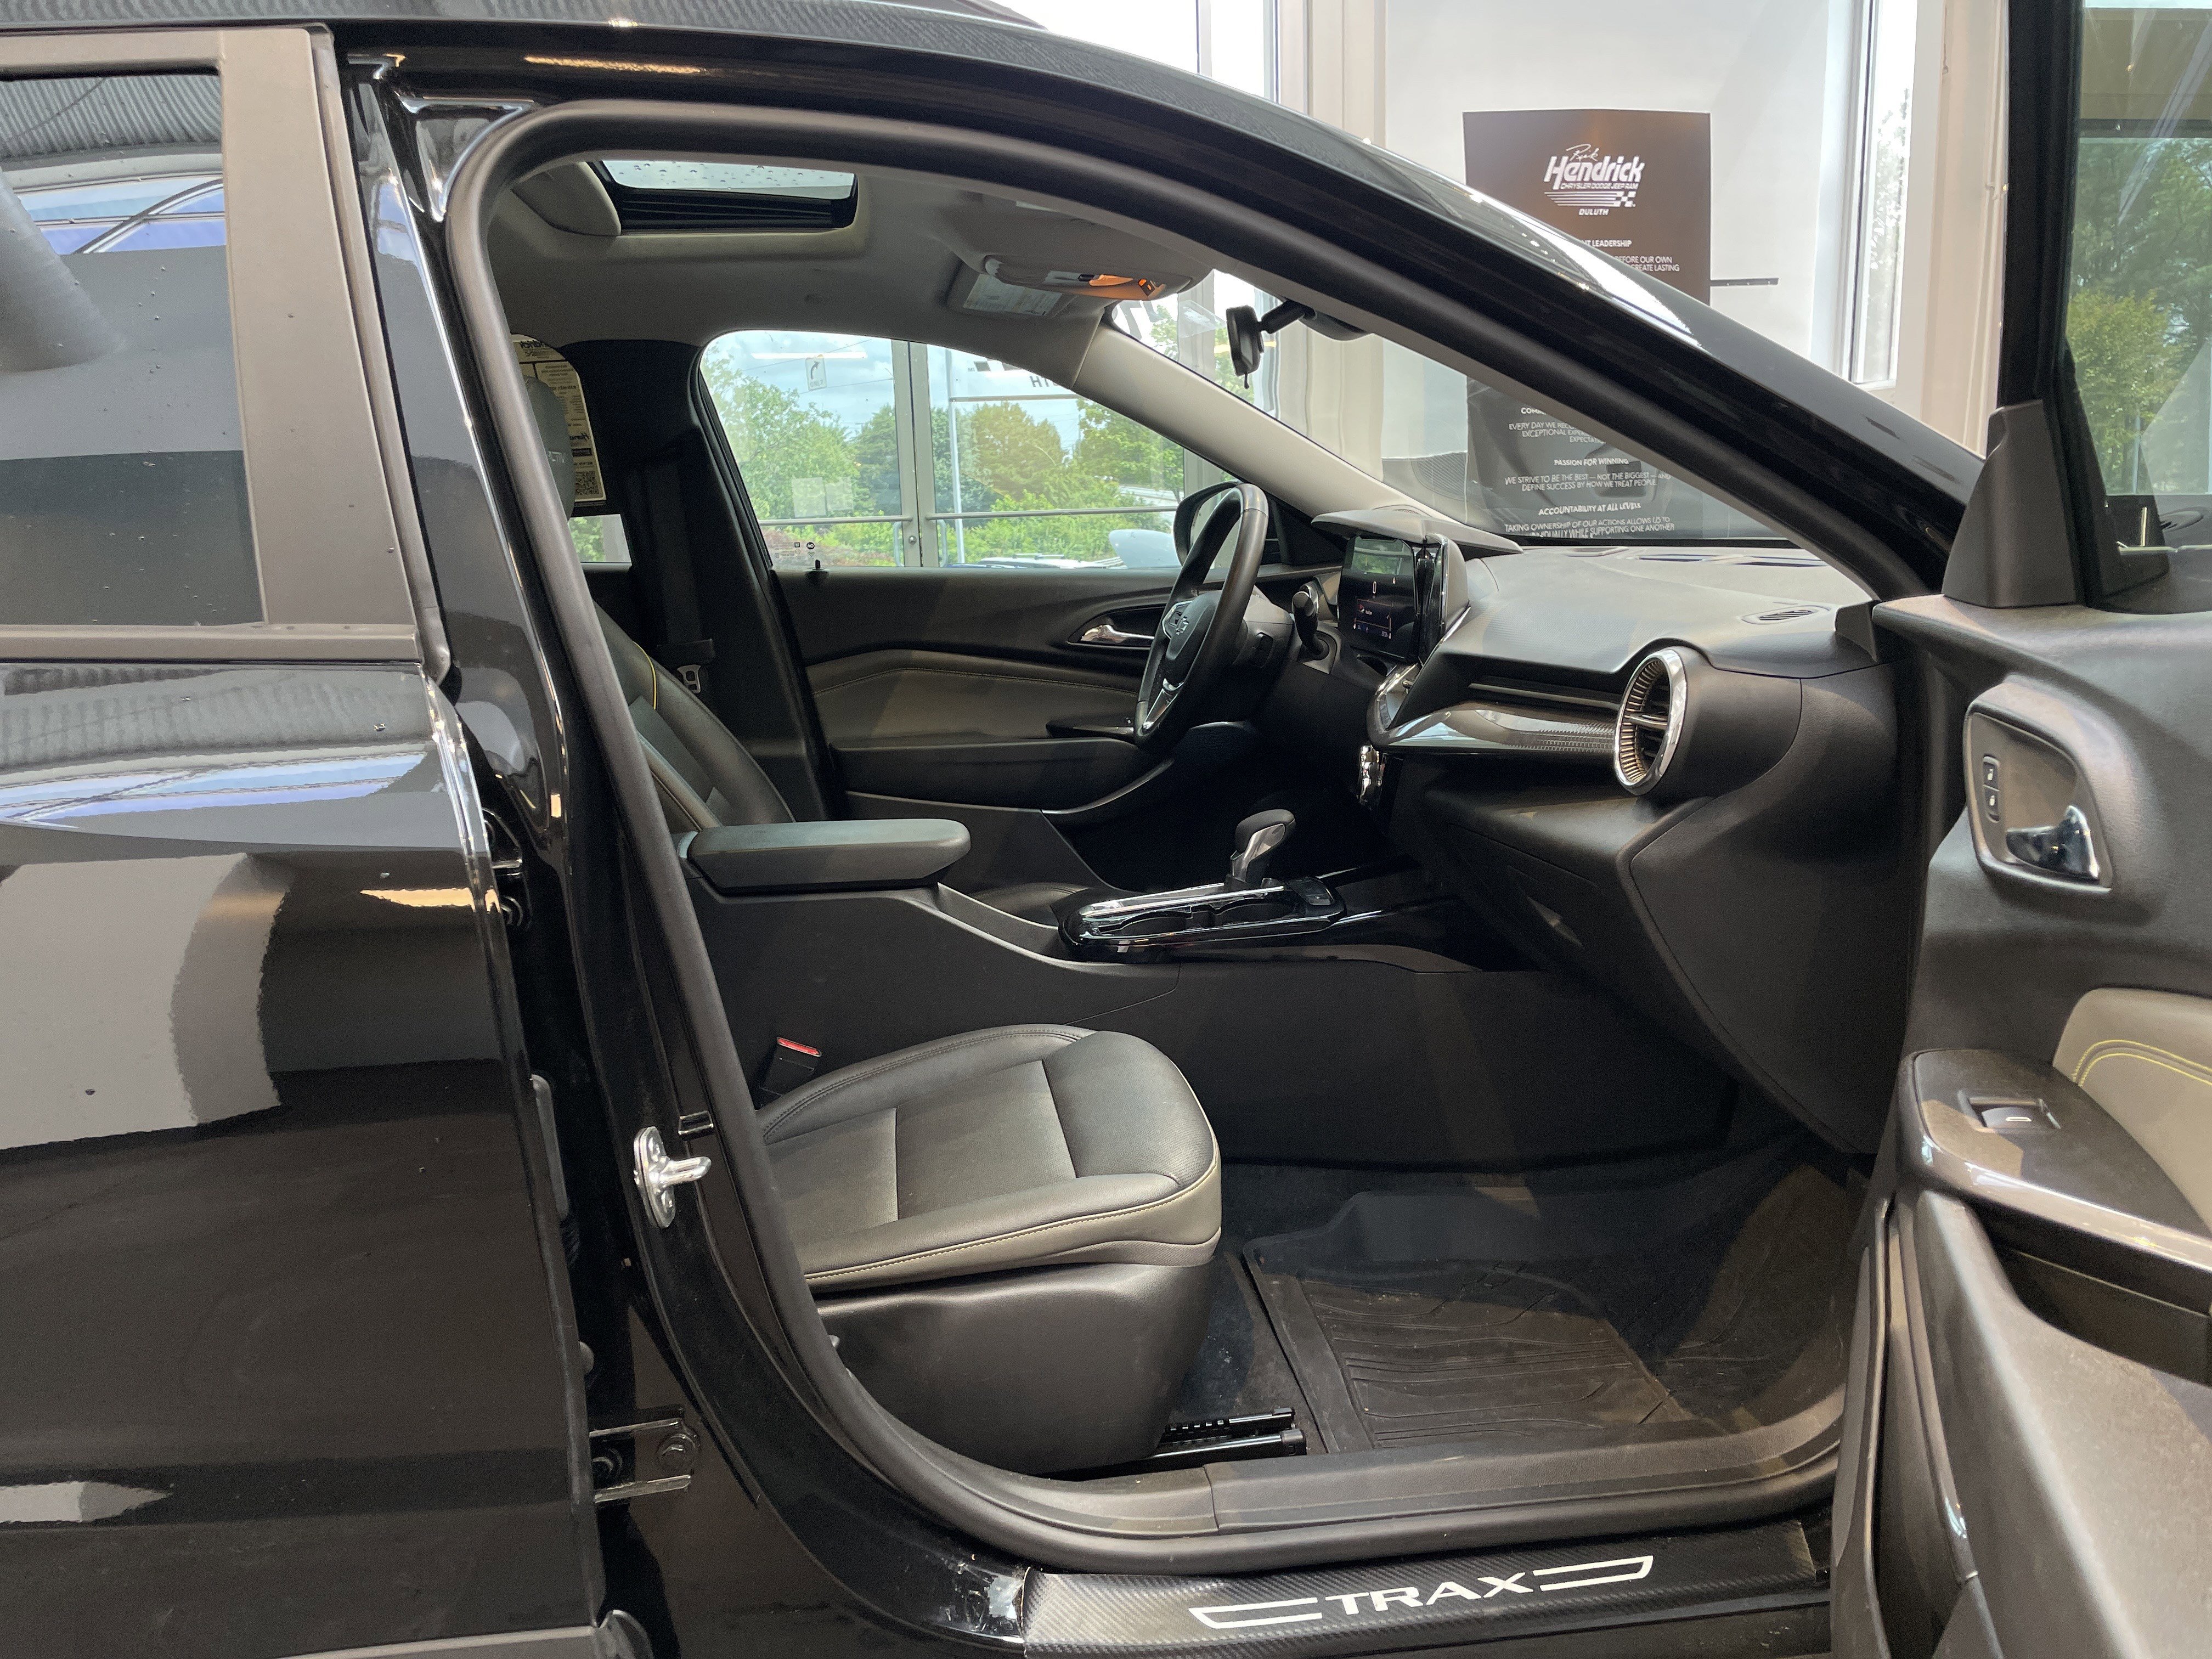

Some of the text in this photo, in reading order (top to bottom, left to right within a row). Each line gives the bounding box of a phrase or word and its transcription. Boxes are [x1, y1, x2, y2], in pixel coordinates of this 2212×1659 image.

[1543, 156, 1645, 190] Hendrick
[1509, 422, 1530, 431] EVERY
[1522, 428, 1566, 438] EXCEPTIONAL
[1504, 476, 1516, 486] WE
[1551, 474, 1560, 482] BE
[1574, 473, 1589, 481] BEST
[1611, 472, 1624, 480] THE
[1521, 483, 1545, 492] DEFINE
[1547, 481, 1576, 490] SUCCESS
[1585, 481, 1603, 489] HOW
[1614, 479, 1633, 488] TREAT
[1538, 502, 1641, 516] ACCOUNTABILITY AT ALL LEVELS
[1504, 523, 1530, 533] TAKING
[1531, 521, 1571, 531] OWNERSHIP
[1571, 521, 1582, 529] OF
[1583, 519, 1597, 527] OUR
[1626, 517, 1651, 525] ALLOWS
[1590, 525, 1629, 539] SUPPORTING
[1629, 524, 1645, 533] ONE
[1645, 522, 1675, 532] ANOTHER
[1325, 1572, 1534, 1615] TRAX
